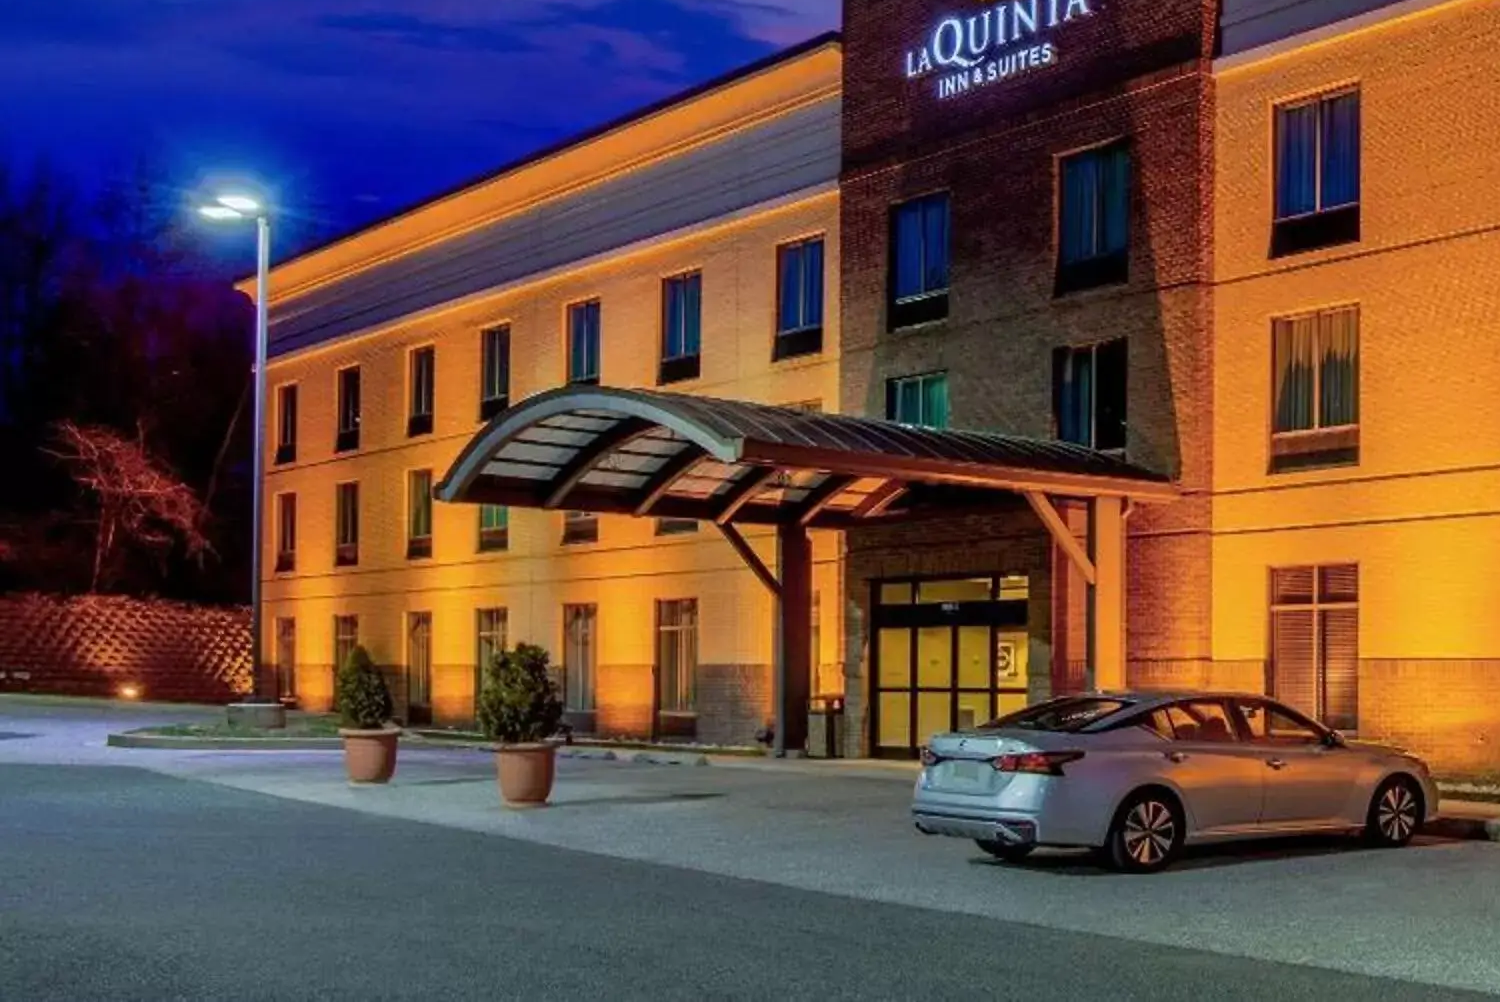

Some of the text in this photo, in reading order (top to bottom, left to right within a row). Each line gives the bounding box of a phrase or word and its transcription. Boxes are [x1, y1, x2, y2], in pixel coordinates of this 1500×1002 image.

[907, 47, 933, 77] LA
[938, 42, 1052, 99] INN & SUITES
